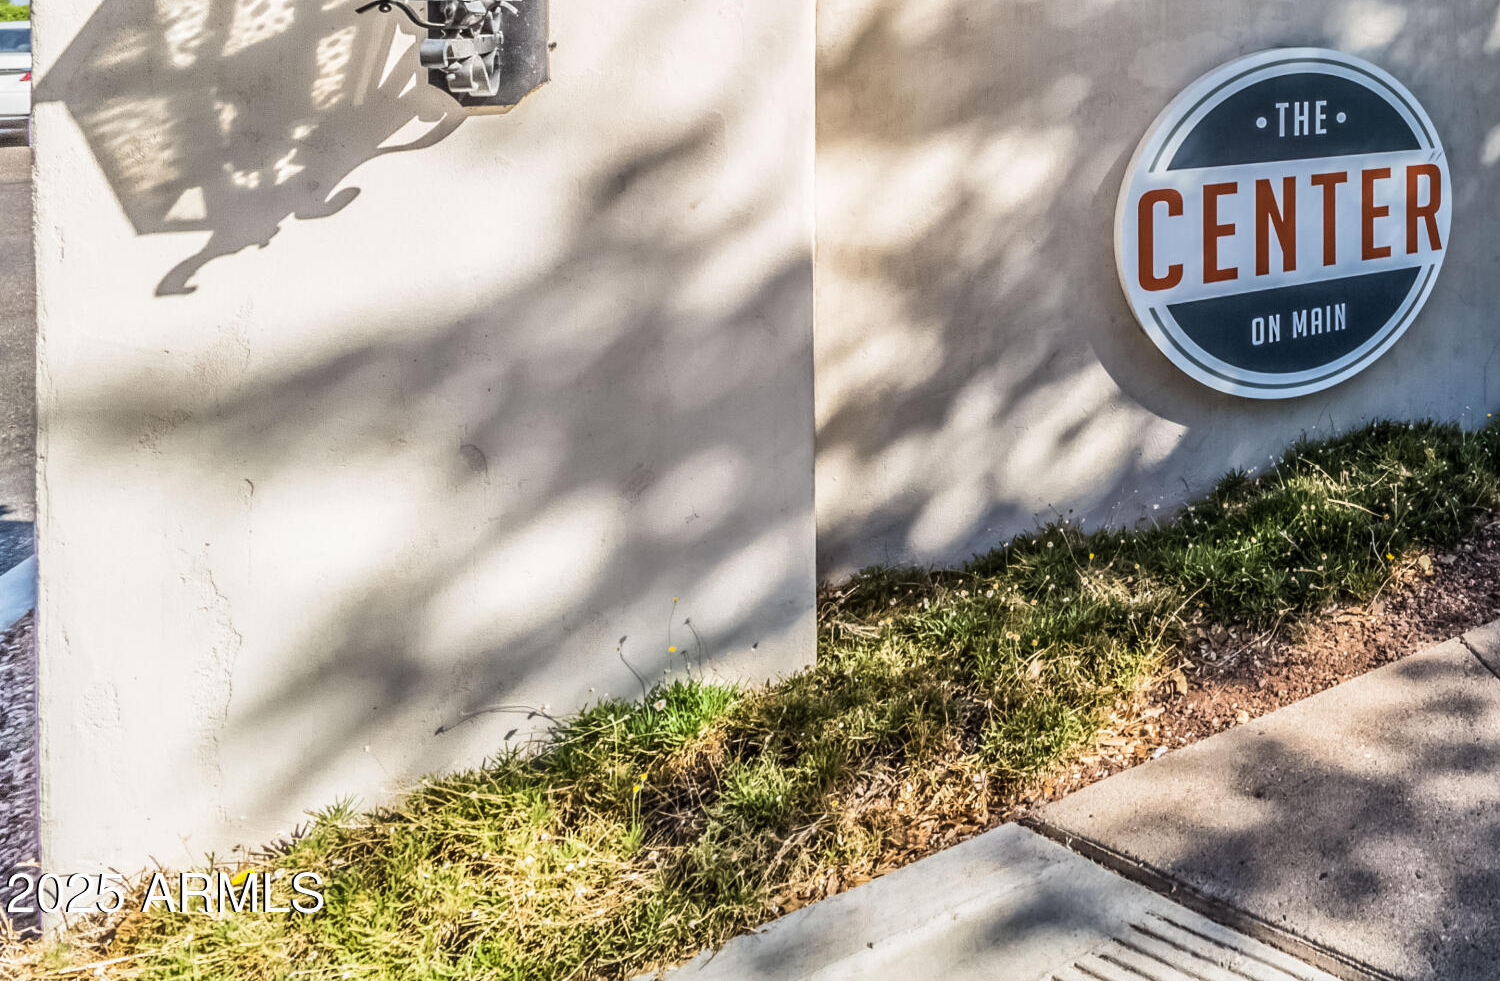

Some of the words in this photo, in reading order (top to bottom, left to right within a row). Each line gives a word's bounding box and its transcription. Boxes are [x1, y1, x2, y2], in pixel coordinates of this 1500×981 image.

[1275, 100, 1328, 137] THE
[1137, 163, 1443, 292] CENTER
[1251, 311, 1281, 346] ON
[1292, 302, 1347, 339] MAIN
